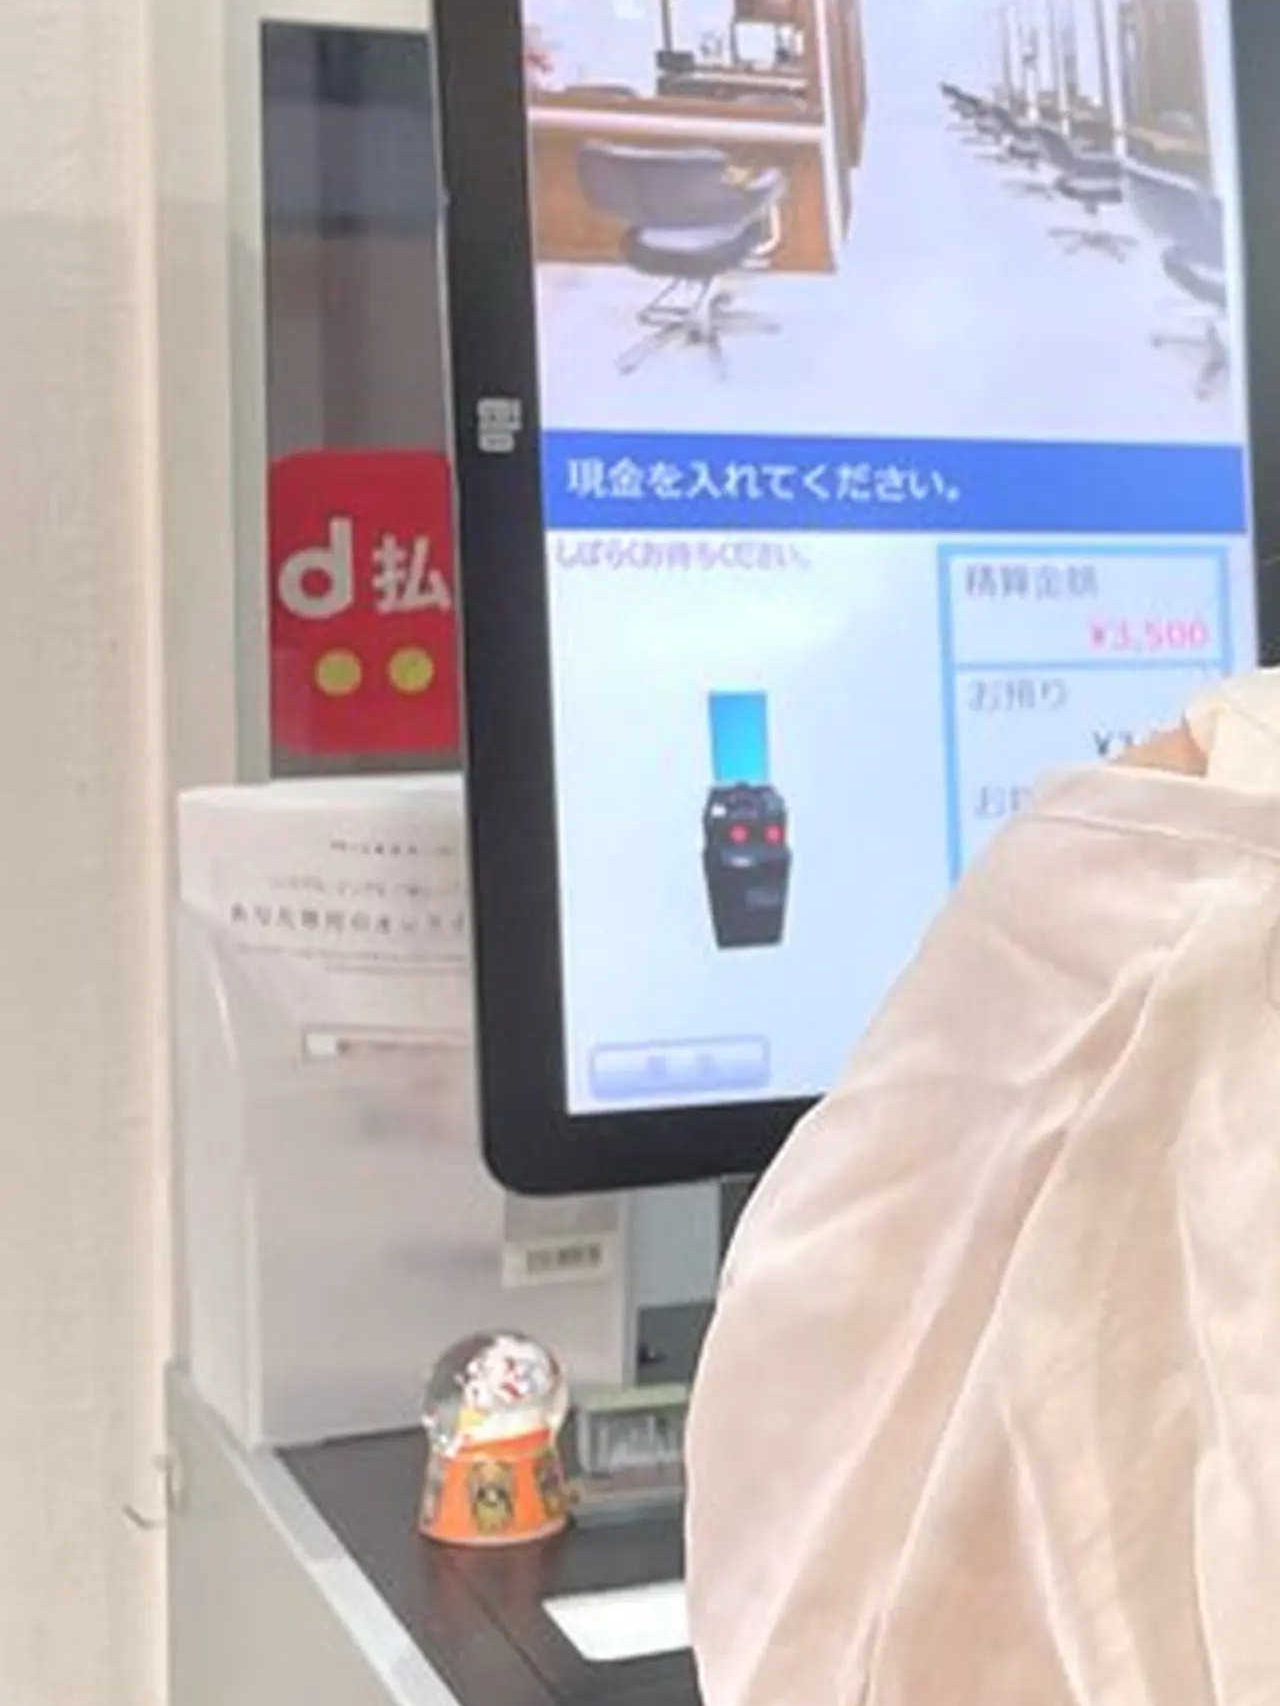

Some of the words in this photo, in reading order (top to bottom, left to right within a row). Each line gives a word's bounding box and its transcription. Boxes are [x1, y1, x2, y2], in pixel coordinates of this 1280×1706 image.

[567, 456, 962, 501] 現金を入れてください。
